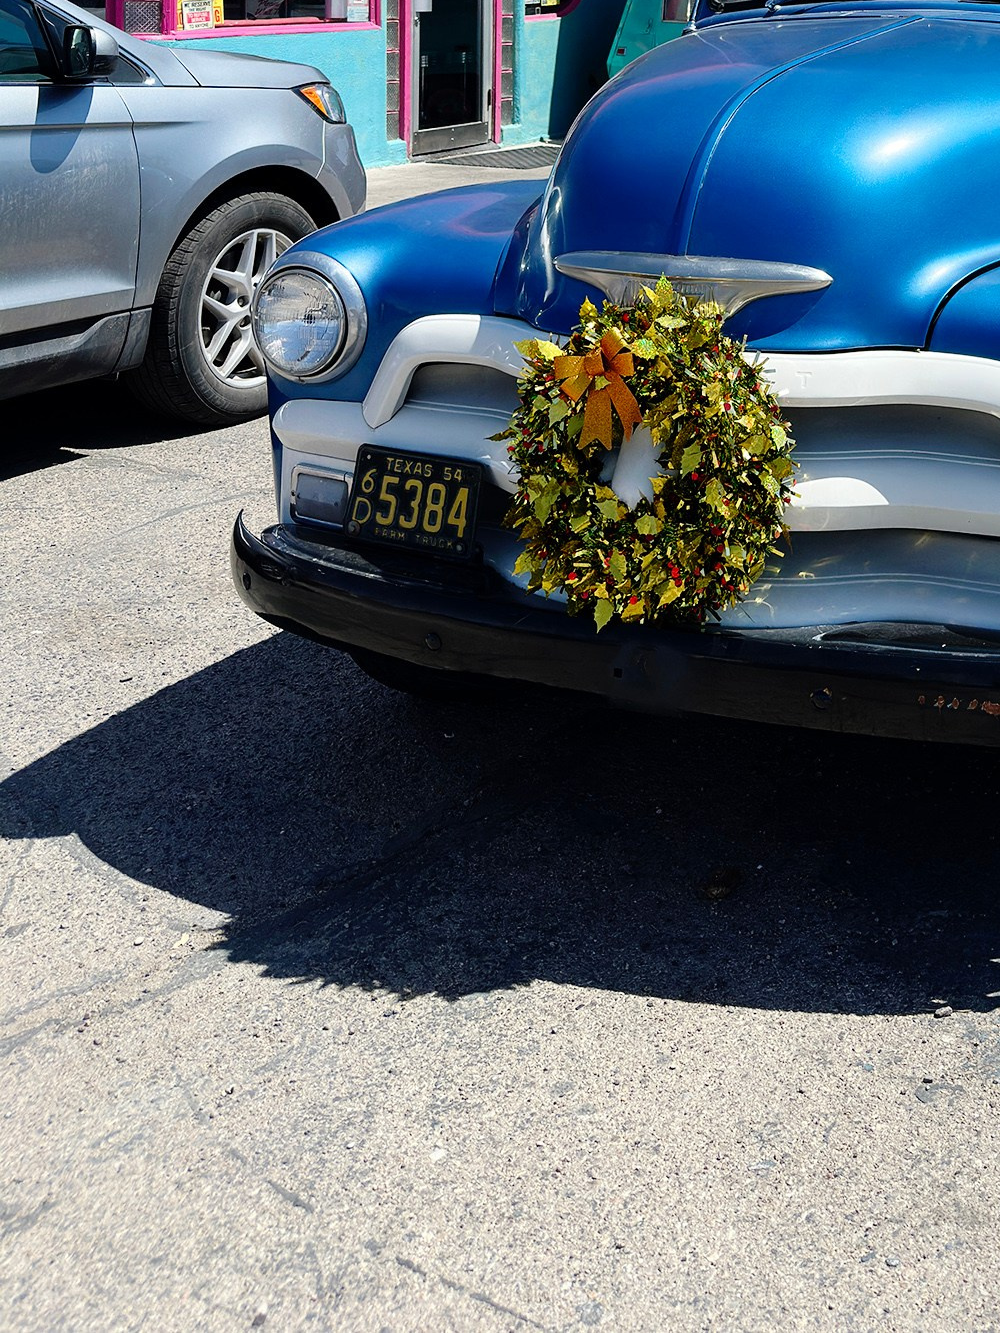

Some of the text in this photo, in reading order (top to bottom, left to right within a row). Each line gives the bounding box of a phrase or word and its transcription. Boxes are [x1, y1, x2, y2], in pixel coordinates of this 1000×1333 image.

[361, 468, 377, 494] 6
[386, 457, 463, 483] TEXAS 54
[352, 497, 372, 524] D
[375, 475, 469, 538] 5384
[375, 527, 453, 549] FARM TRUCK
